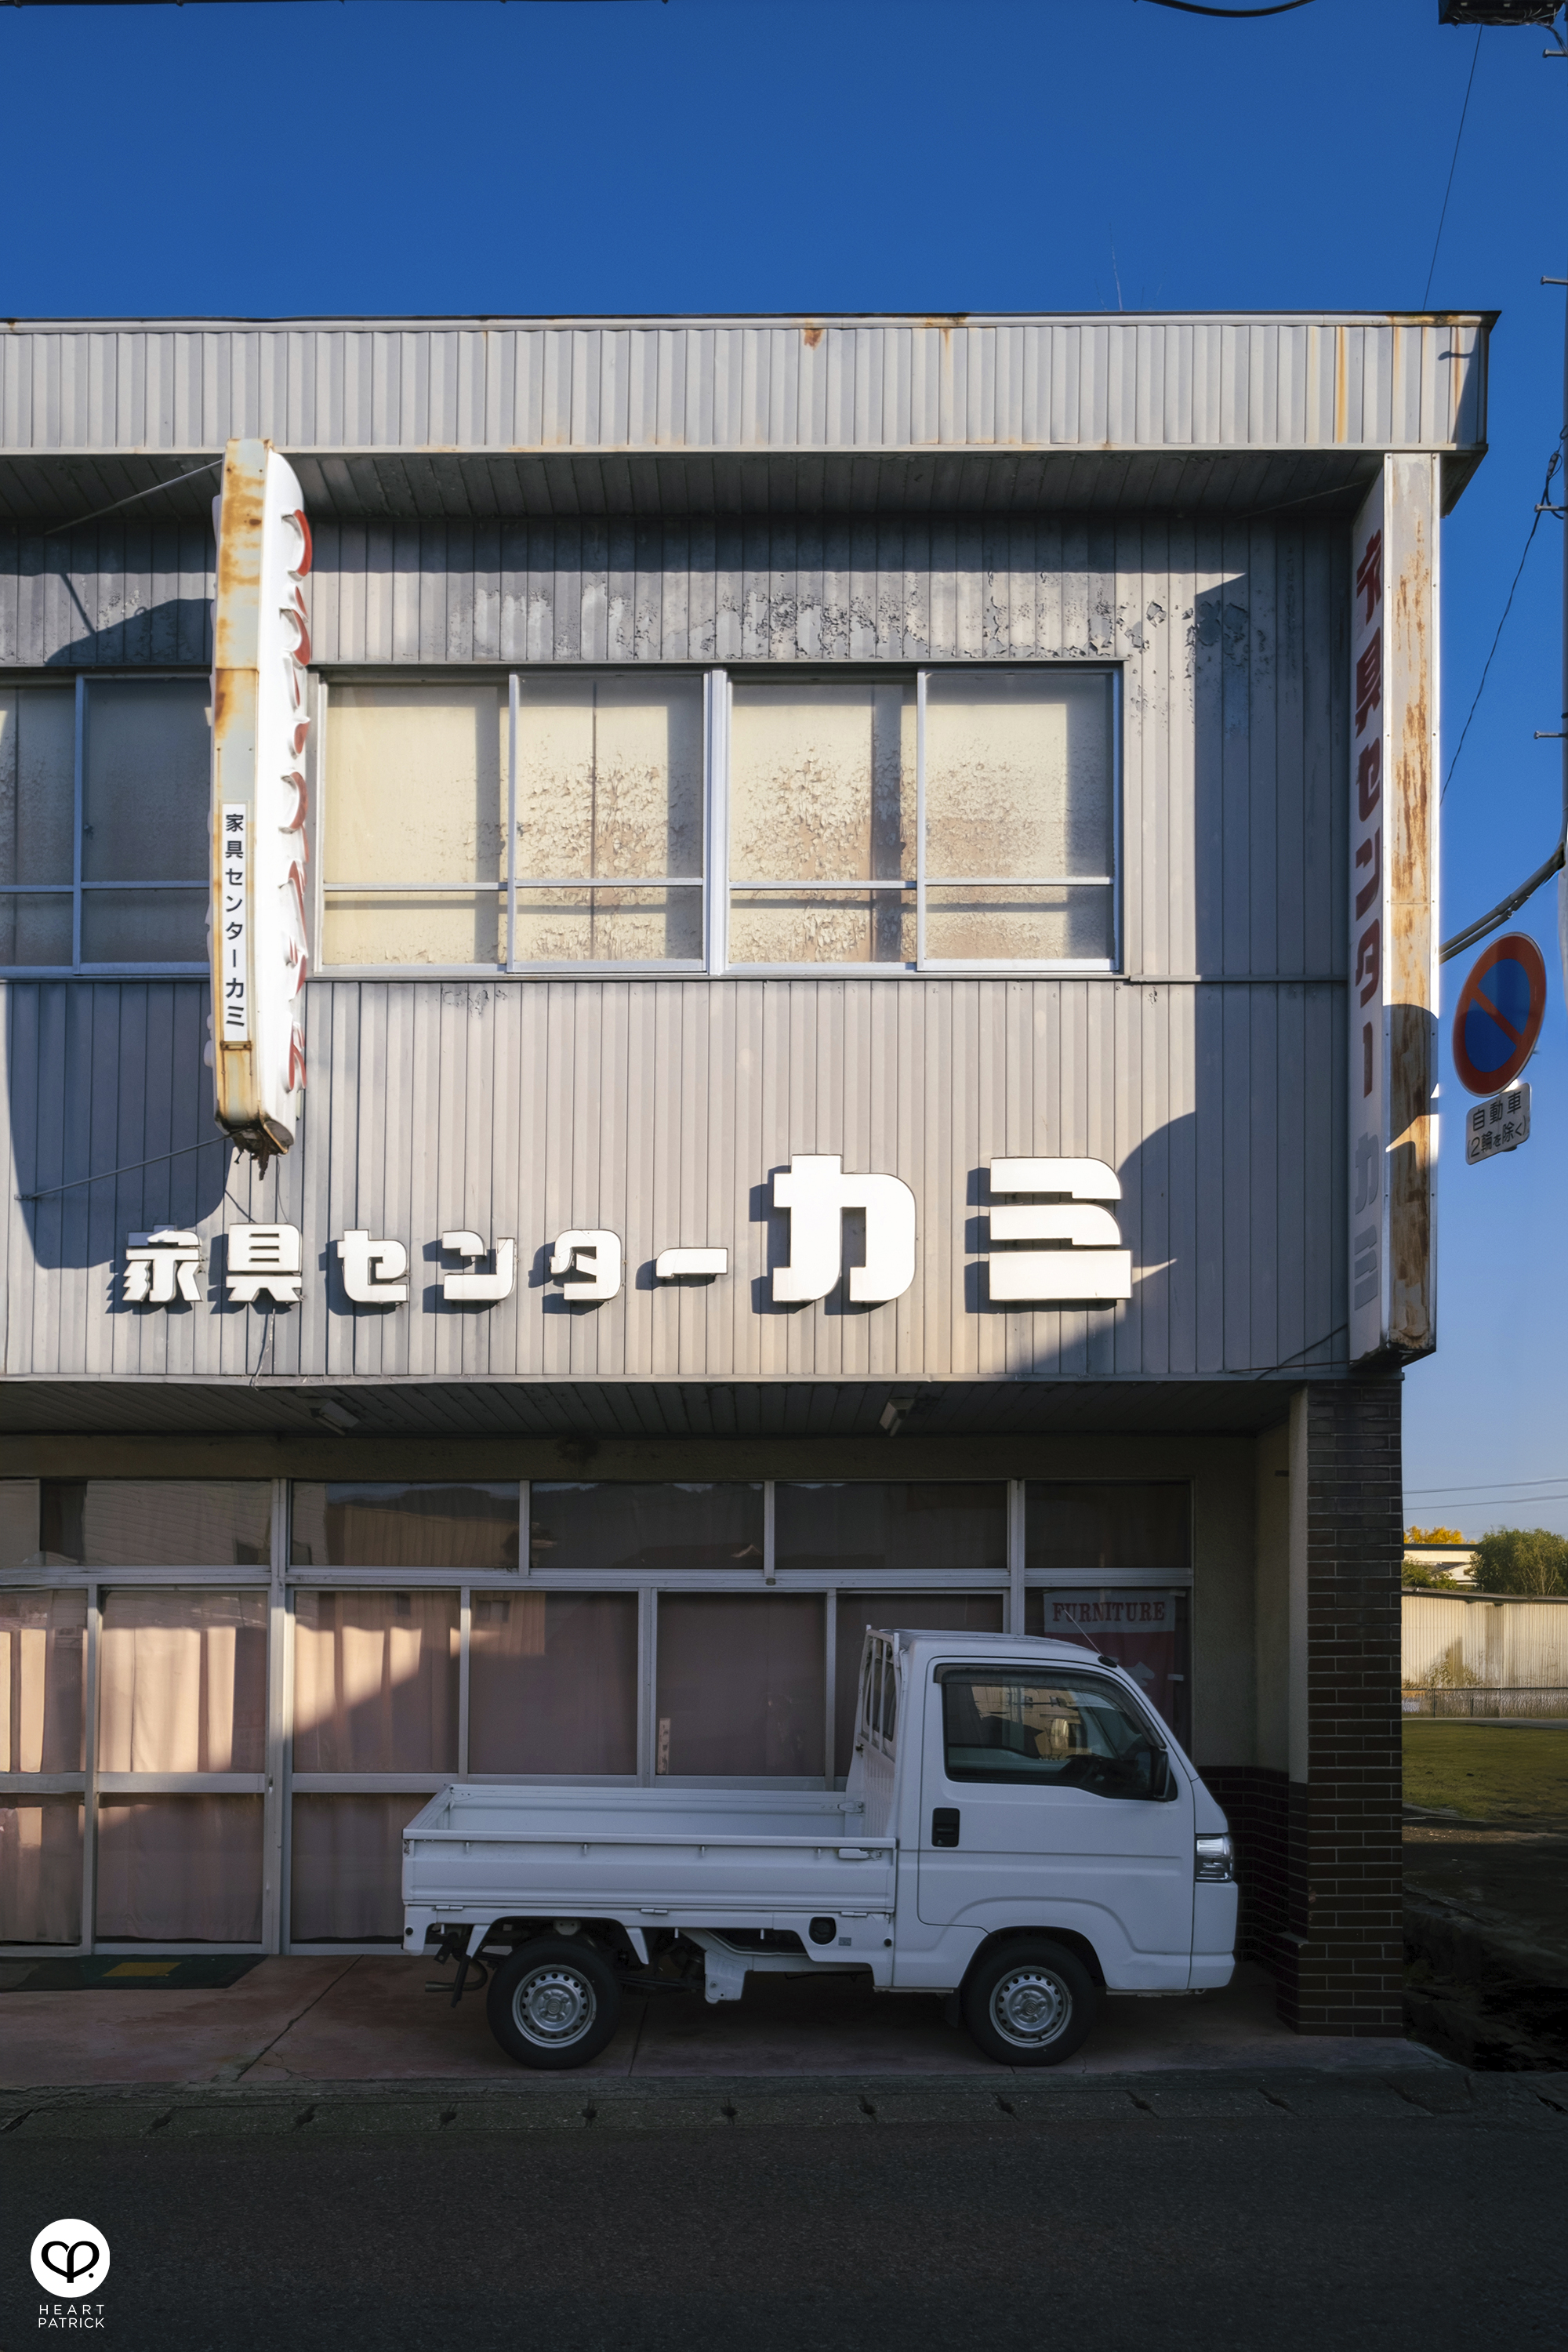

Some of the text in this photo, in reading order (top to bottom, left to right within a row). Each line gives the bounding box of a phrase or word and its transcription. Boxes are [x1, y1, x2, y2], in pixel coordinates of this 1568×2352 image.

[225, 813, 245, 1027] 家具センターカミ
[1473, 1091, 1522, 1131] 自動車
[1467, 1115, 1526, 1159] (2輪を除く)
[1052, 1601, 1165, 1622] FURNITURE
